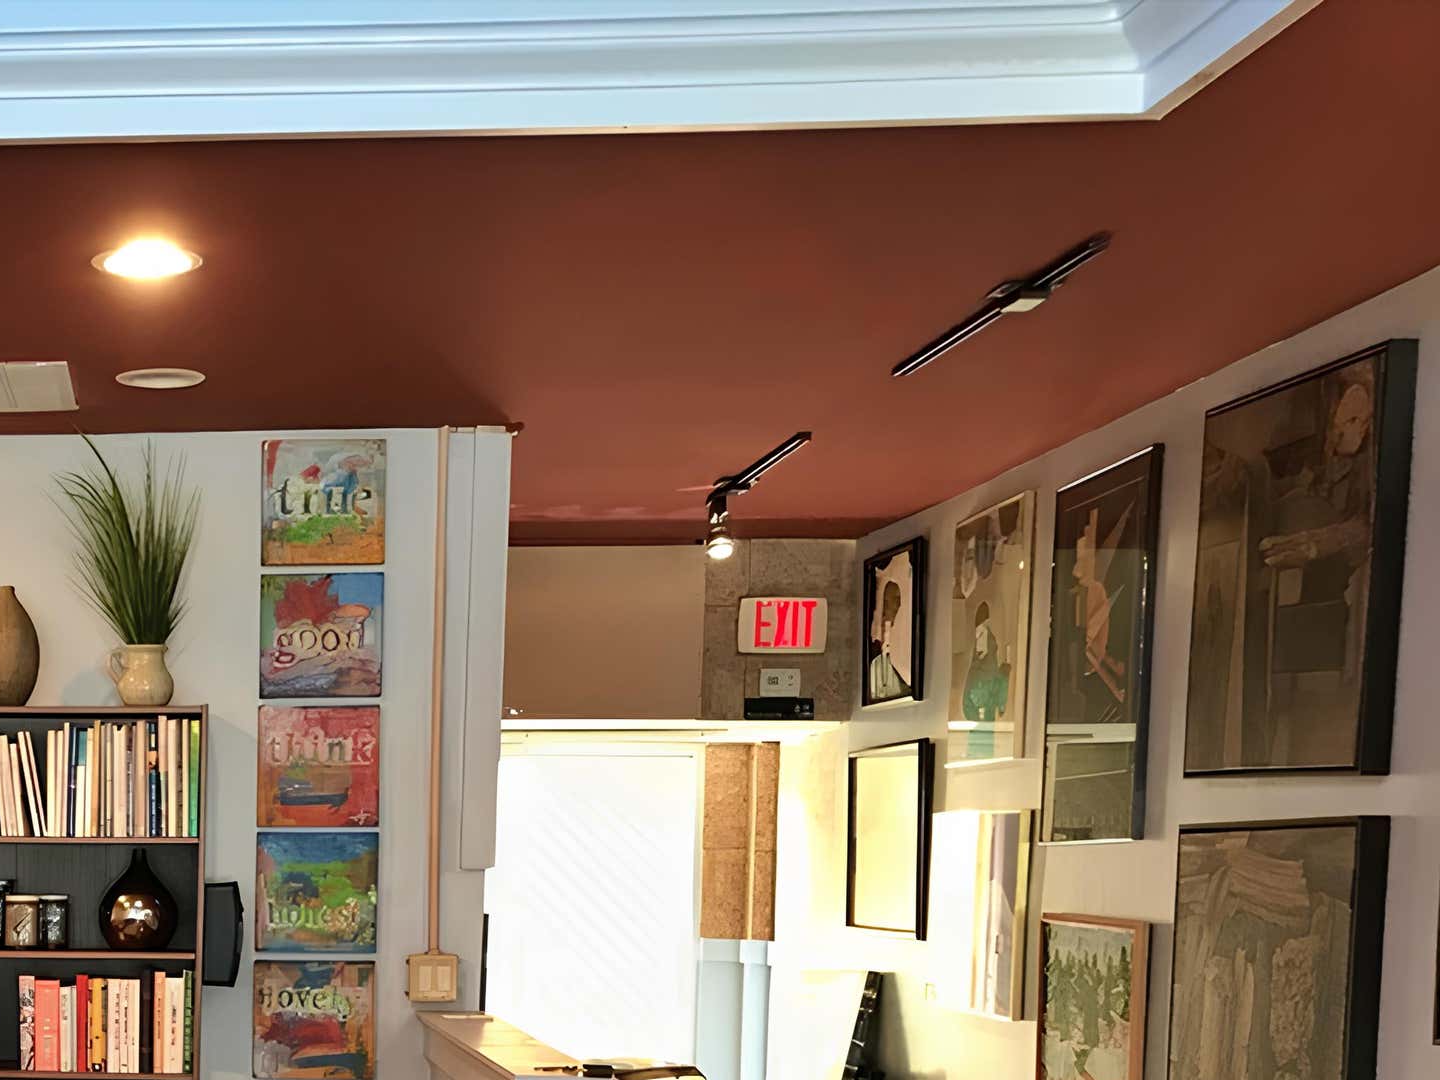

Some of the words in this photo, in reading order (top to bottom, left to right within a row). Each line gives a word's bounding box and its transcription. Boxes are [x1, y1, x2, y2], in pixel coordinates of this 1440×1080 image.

[268, 477, 373, 516] true
[271, 620, 365, 664] good
[753, 600, 818, 648] EXIT
